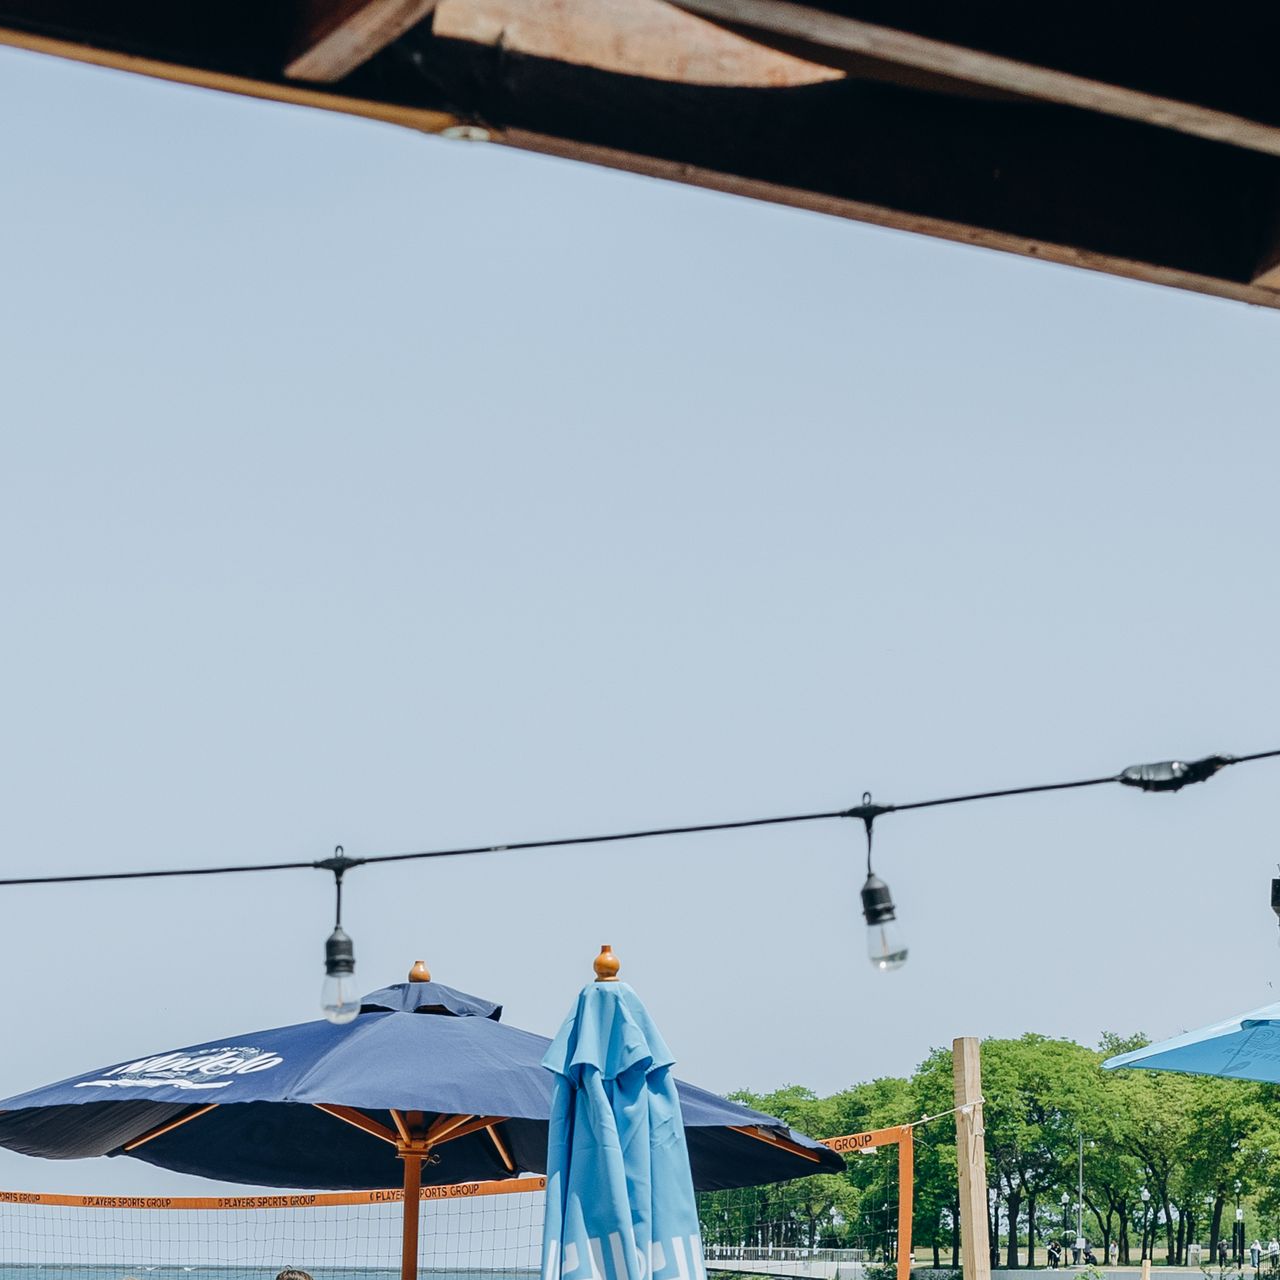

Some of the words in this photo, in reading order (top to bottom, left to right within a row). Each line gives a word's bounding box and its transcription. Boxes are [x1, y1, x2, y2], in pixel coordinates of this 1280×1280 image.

[834, 1134, 873, 1151] GROUP
[376, 1190, 405, 1201] PLAYER
[420, 1186, 447, 1198] PORTS
[450, 1184, 480, 1196] GROUP
[87, 1196, 116, 1207] PLAYERS
[118, 1197, 145, 1208] SPORTS
[147, 1198, 172, 1209] GROUP
[224, 1198, 256, 1208] PLAYERS
[258, 1196, 288, 1207] SPORTS
[290, 1195, 316, 1206] GROUP
